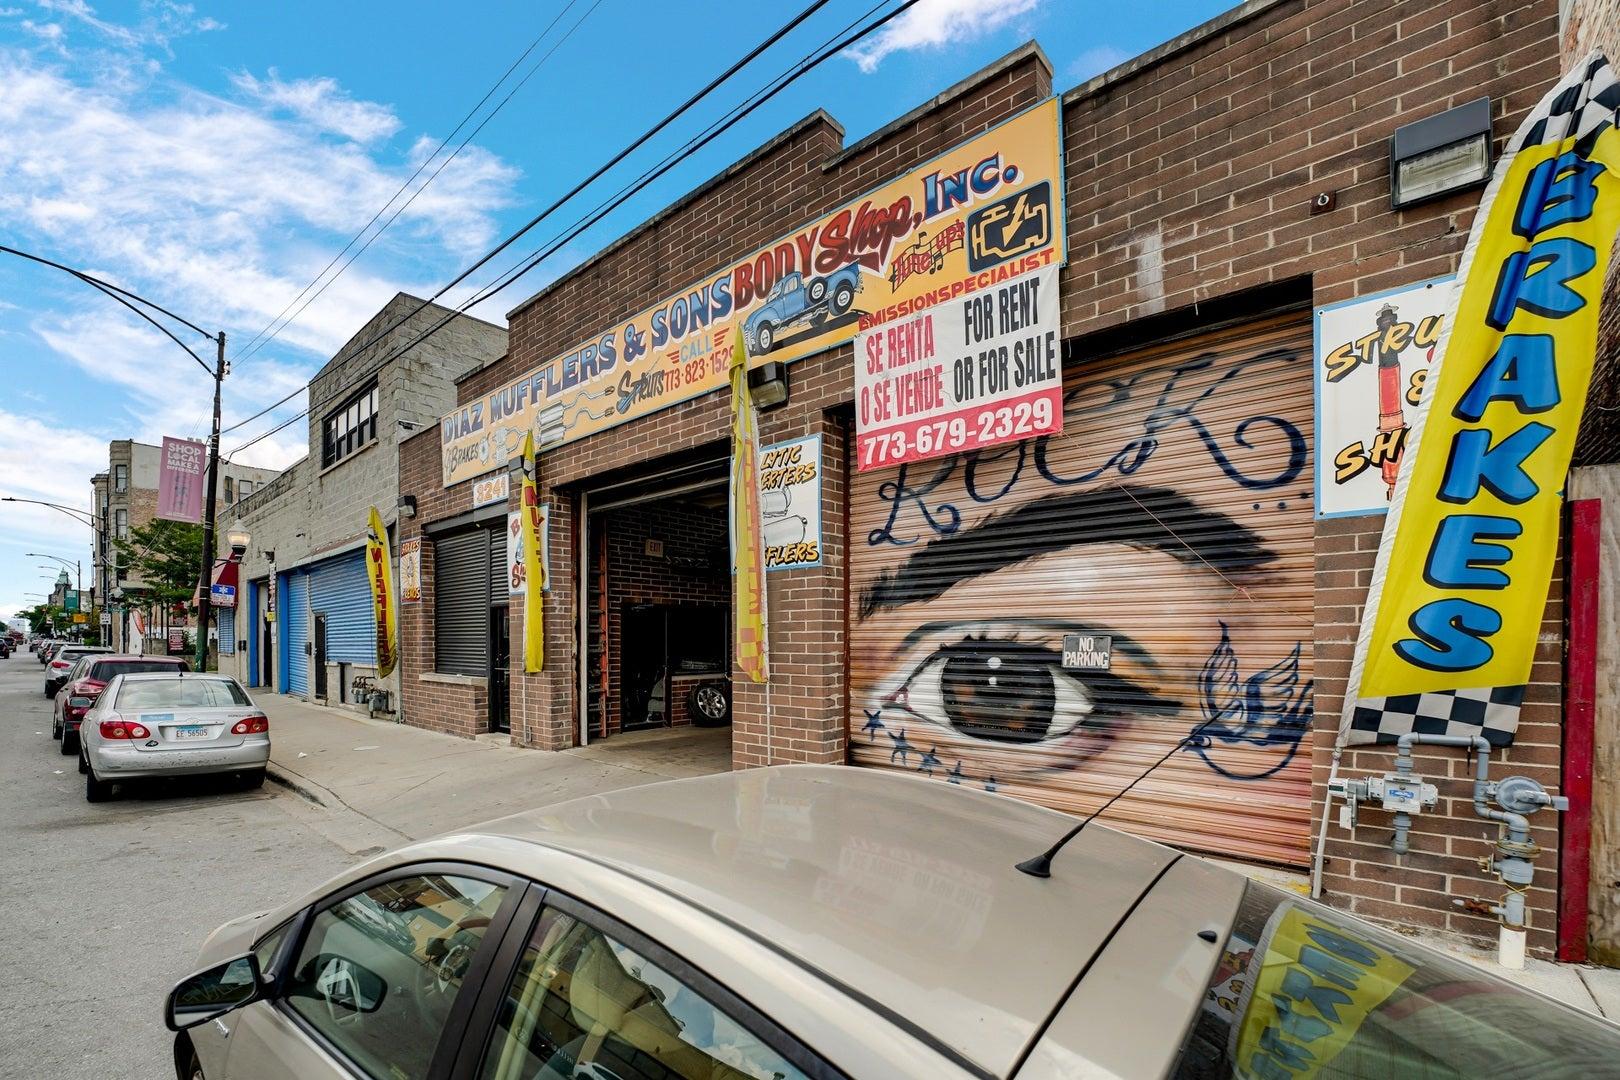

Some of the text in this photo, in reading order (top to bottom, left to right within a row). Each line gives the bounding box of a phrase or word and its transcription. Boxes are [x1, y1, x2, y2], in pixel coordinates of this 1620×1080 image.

[964, 277, 1040, 346] FOR RENT
[443, 401, 484, 444] DIAZ
[490, 331, 617, 424] MUFFLERS
[624, 323, 646, 362] &
[651, 272, 732, 351] SONS
[735, 226, 820, 308] BODY
[681, 334, 713, 362] CALL
[866, 314, 934, 375] SE RENTA
[1325, 314, 1445, 382] STRU
[953, 330, 1056, 403] OR FOR SALE
[861, 364, 944, 426] O SE VENDE
[1392, 150, 1606, 674] BRAKES
[864, 397, 1053, 465] 773-679-2329
[167, 451, 201, 464] LOCAL
[167, 459, 193, 469] MAKE
[168, 442, 201, 456] SHOP
[760, 444, 802, 470] LYTIC
[761, 461, 817, 491] ERTERS
[764, 540, 819, 567] FLERS
[1063, 650, 1109, 669] PARKING
[1078, 637, 1094, 652] NO
